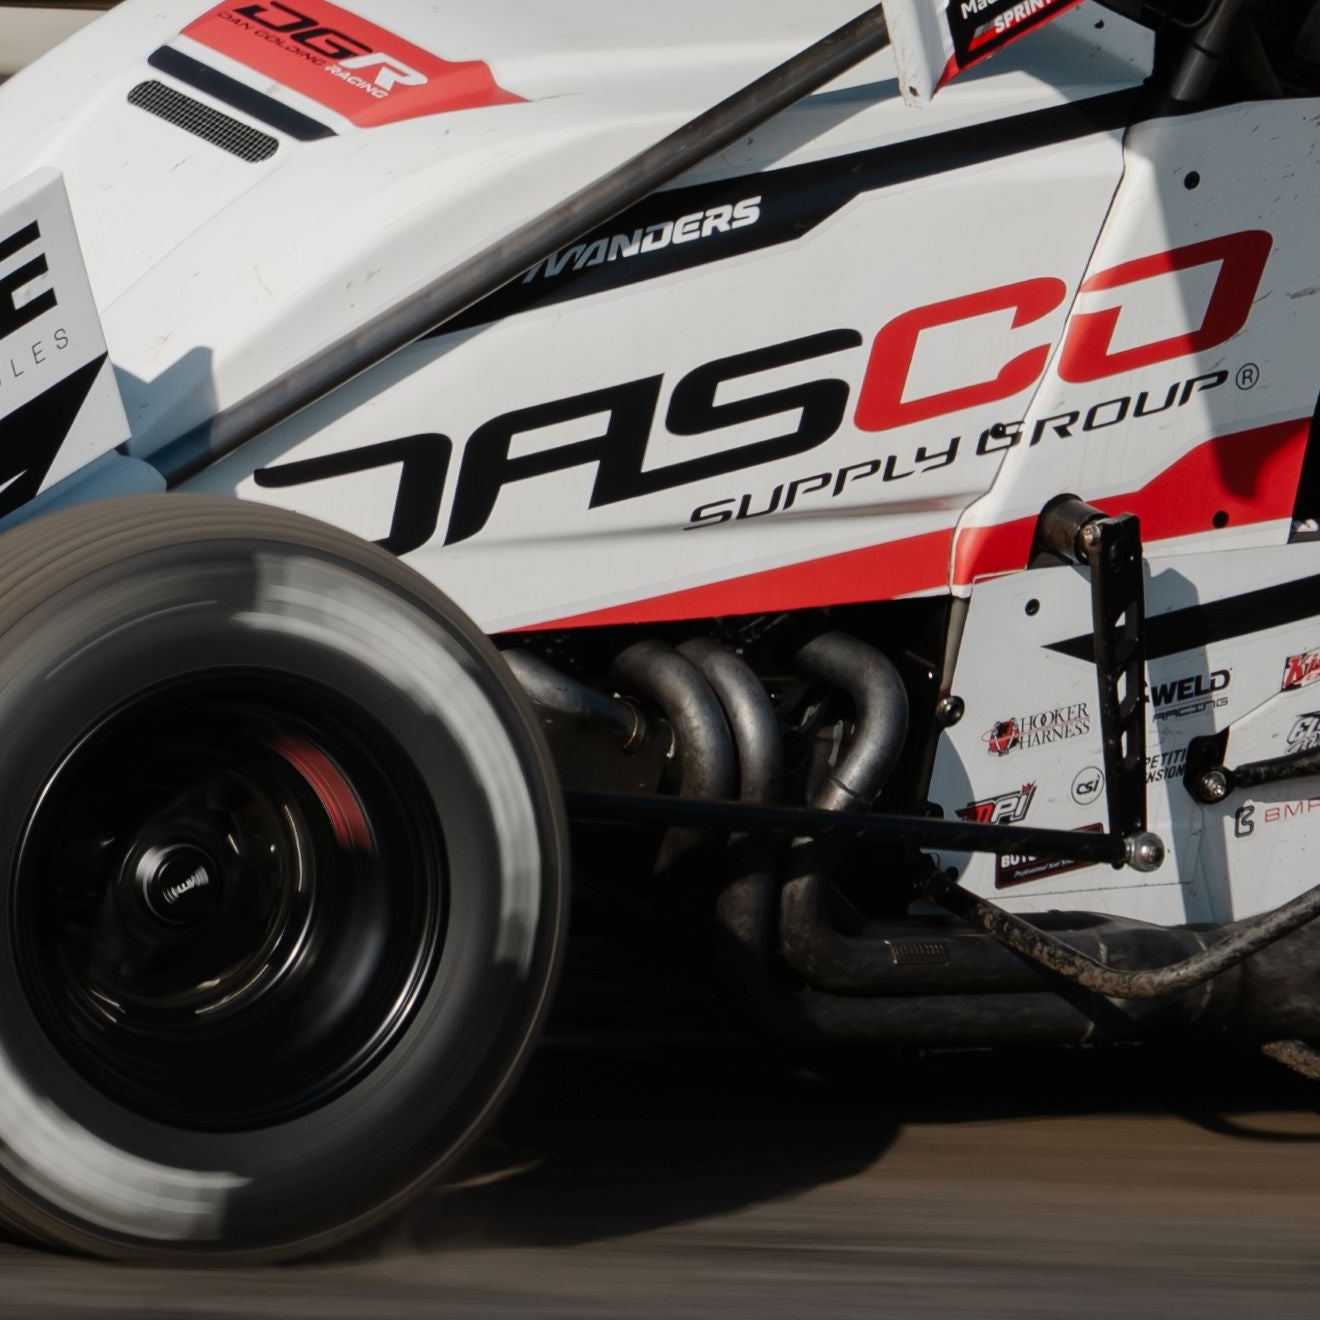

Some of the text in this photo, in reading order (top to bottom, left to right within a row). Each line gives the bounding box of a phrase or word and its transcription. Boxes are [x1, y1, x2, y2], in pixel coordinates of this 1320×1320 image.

[324, 64, 389, 99] RACING
[683, 368, 1231, 532] SUPPLY GROUP
[1151, 669, 1231, 707] WELD
[1021, 702, 1089, 733] HOOKER
[1020, 721, 1090, 750] HARNESS
